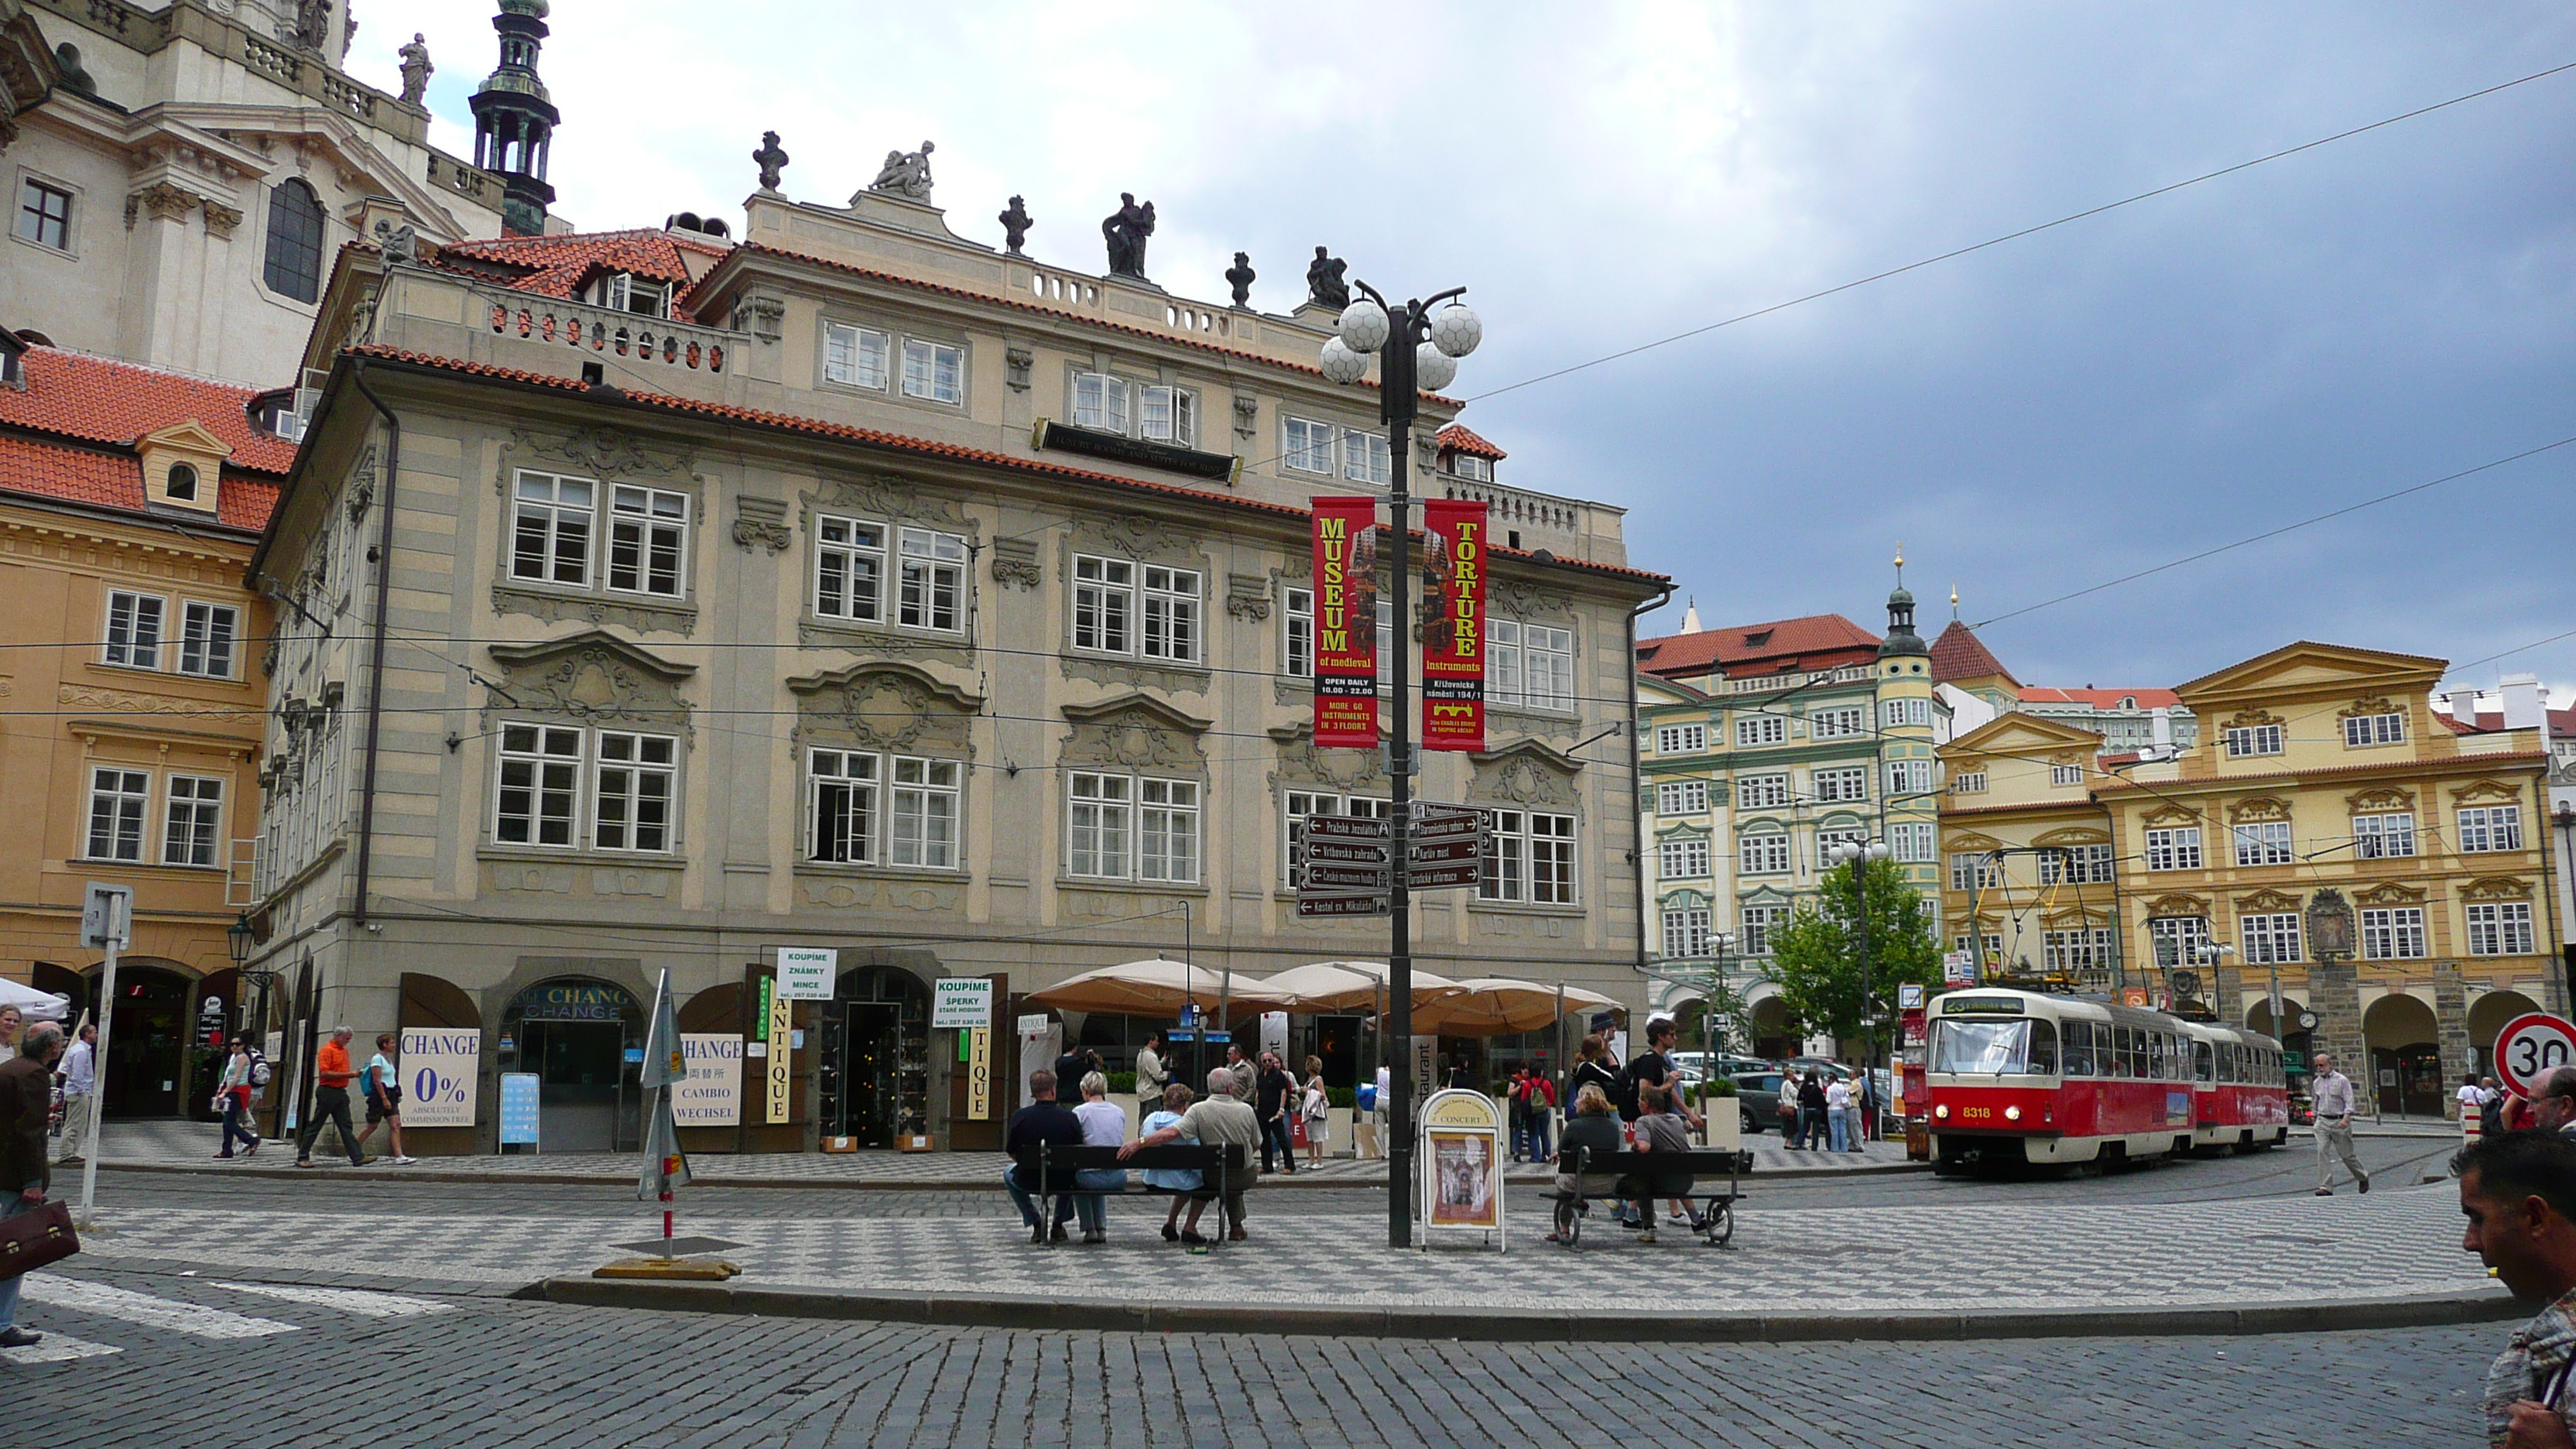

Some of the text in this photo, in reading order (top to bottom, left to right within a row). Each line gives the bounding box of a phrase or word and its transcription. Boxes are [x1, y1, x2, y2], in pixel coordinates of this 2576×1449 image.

[1319, 517, 1348, 652] MUSEUM
[1454, 522, 1478, 657] TORTURE
[1320, 656, 1371, 668] of medieval
[1427, 660, 1481, 672] instruments
[1329, 701, 1348, 710] MORE
[1322, 711, 1370, 721] INSTRUMENTS
[1314, 900, 1334, 913] Kostel
[1345, 899, 1372, 911] Mikuláše
[788, 952, 827, 961] KOUPÍME
[789, 966, 825, 975] ZNÁMKY
[938, 980, 989, 991] KOUPÍME
[946, 995, 979, 1005] ŠPERKY
[1946, 1001, 1965, 1012] 23
[525, 1005, 621, 1020] CHANGE
[1019, 1017, 1045, 1028] ANTIQUE
[402, 1034, 478, 1055] CHANGE
[683, 1040, 742, 1059] HANGE
[772, 999, 786, 1116] ANTIQUE
[2513, 1036, 2568, 1077] 30
[974, 1032, 987, 1113] TIQUE
[1418, 1043, 1430, 1107] staurant
[415, 1067, 464, 1103] 0%
[682, 1088, 731, 1098] CAMBIO
[413, 1105, 461, 1114] ABSOLUTELY
[677, 1108, 734, 1118] WECHSEL
[1963, 1107, 1991, 1118] 8318
[401, 1115, 470, 1124] COMMISSION FREE
